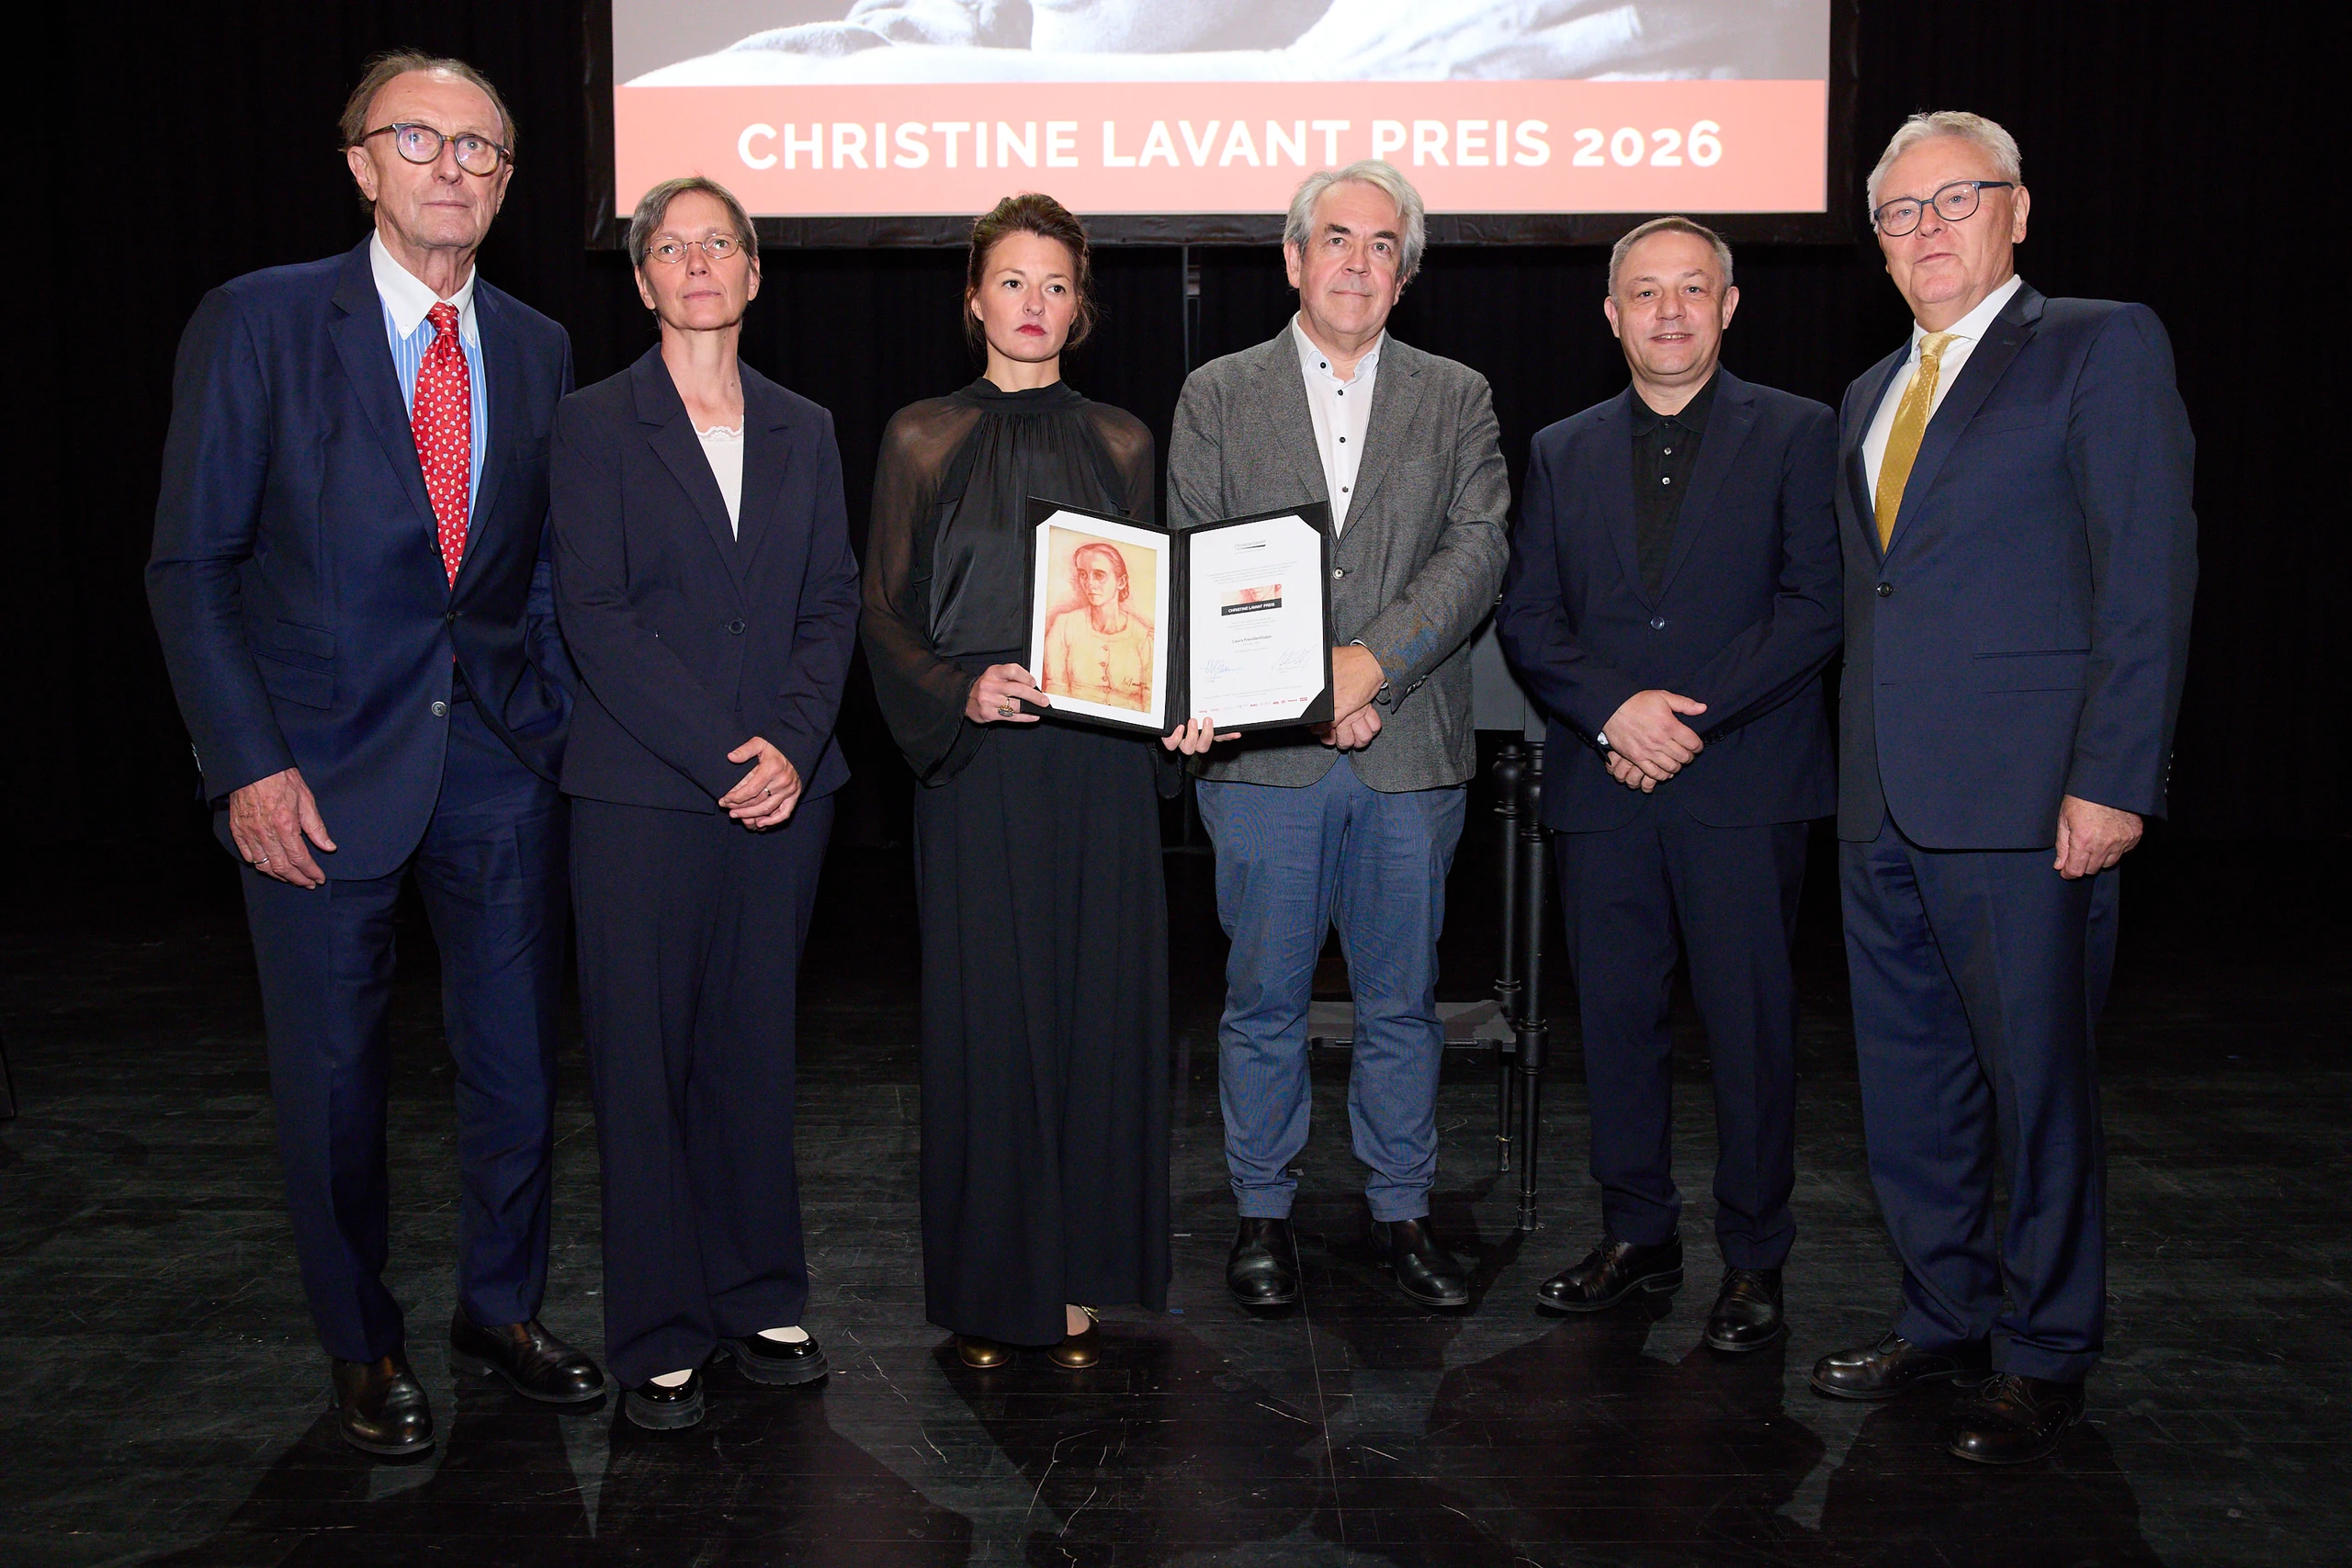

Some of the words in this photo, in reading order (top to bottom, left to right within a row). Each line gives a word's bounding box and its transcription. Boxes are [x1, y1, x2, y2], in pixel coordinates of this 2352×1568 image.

[737, 121, 1079, 170] CHRISTINE
[1102, 119, 1351, 168] LAVANT
[1372, 119, 1551, 167] PREIS
[1572, 119, 1723, 167] 2026
